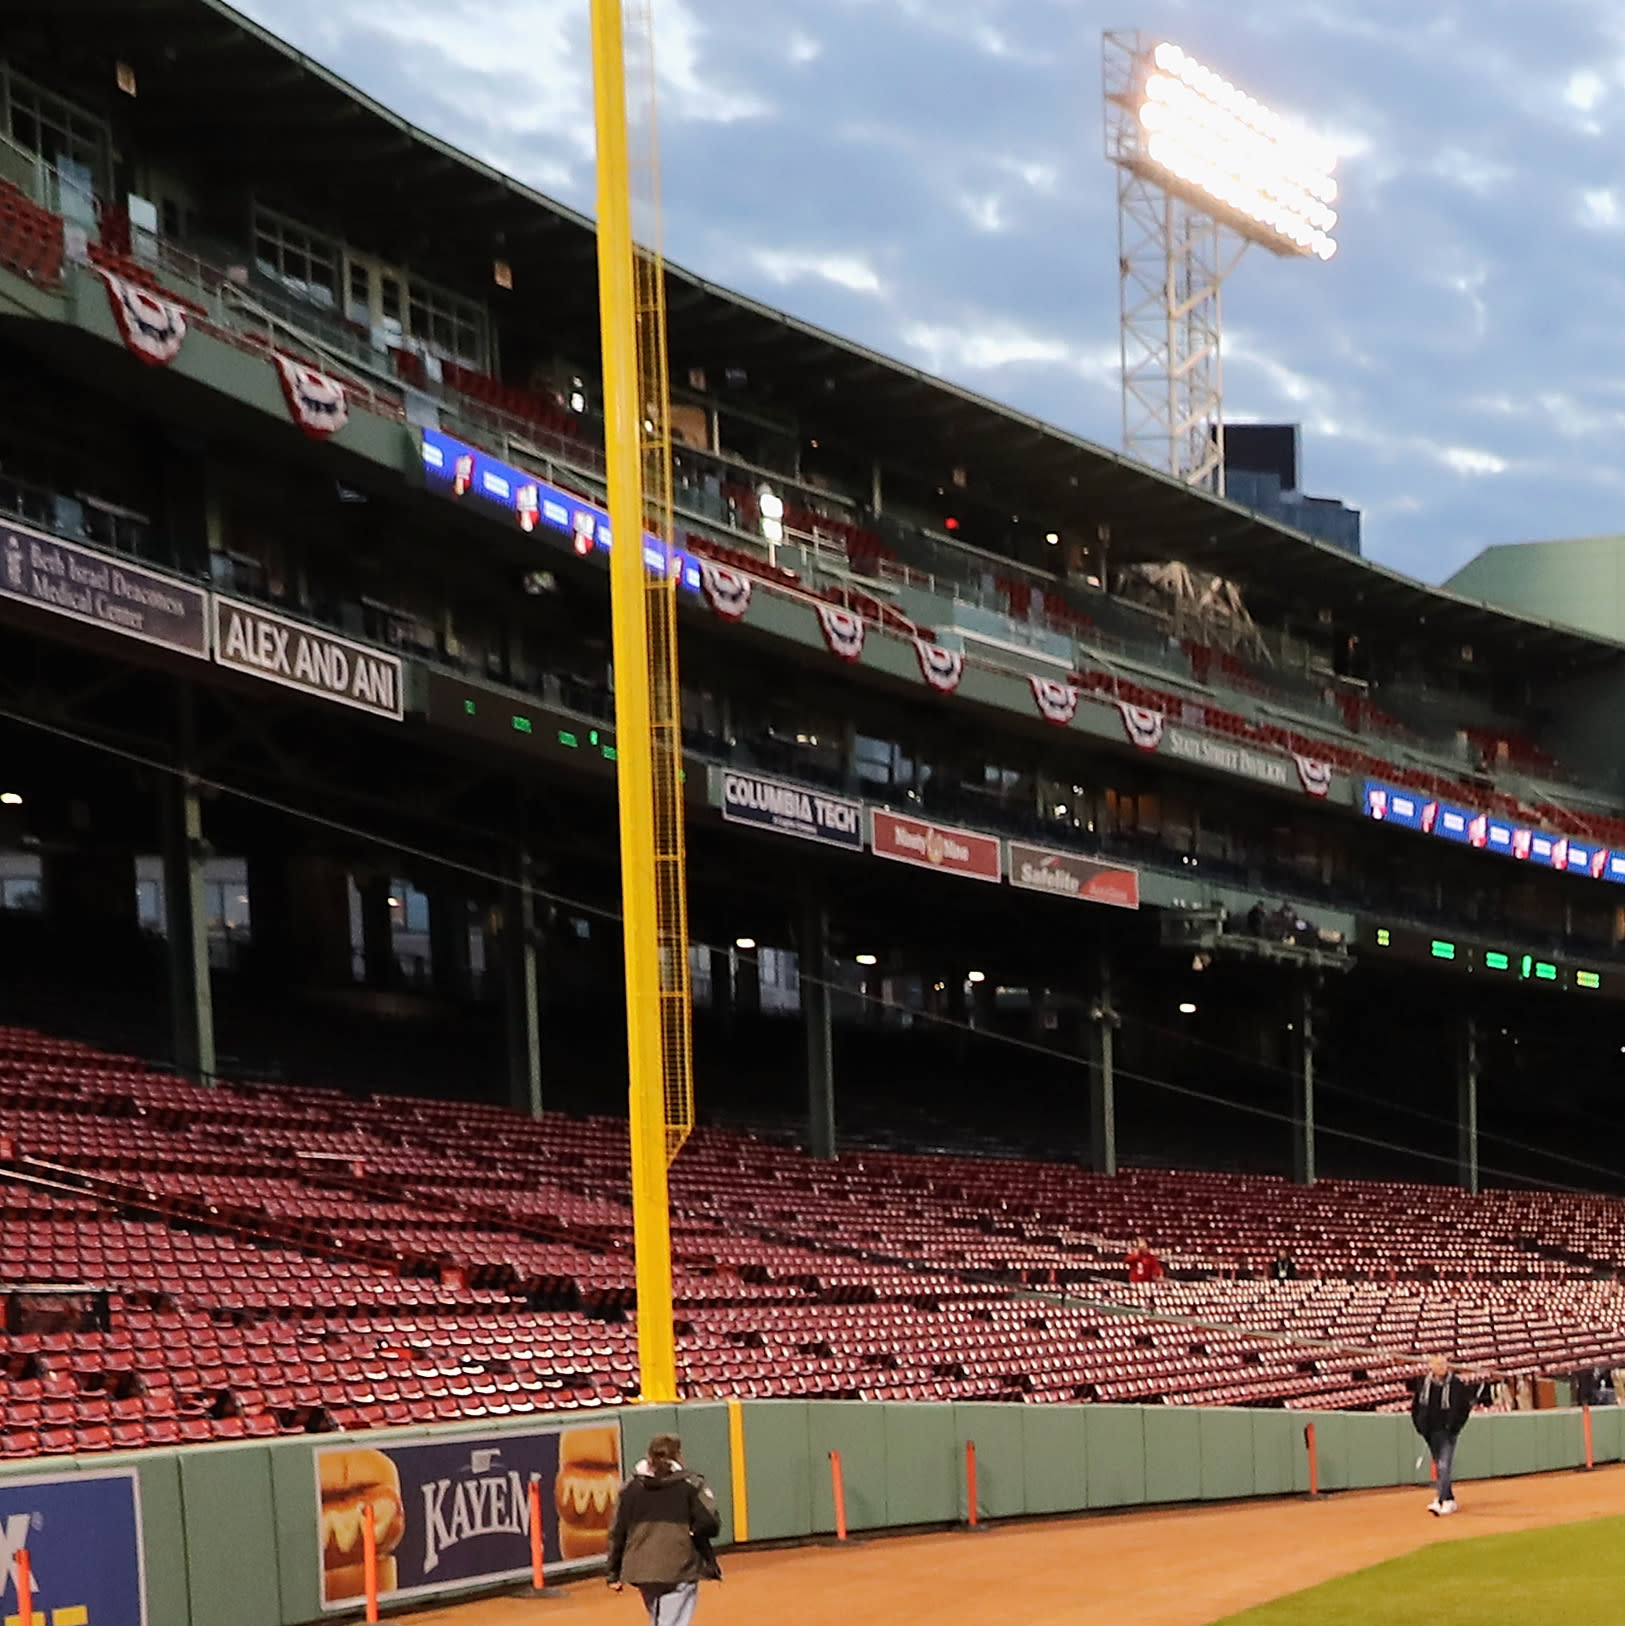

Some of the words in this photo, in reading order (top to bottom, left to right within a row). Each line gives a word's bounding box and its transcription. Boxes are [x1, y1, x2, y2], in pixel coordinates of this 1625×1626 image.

[226, 611, 292, 676] ALEX
[294, 635, 349, 692] AND
[352, 655, 394, 710] ANI
[725, 775, 814, 823] COLUMBIA
[814, 799, 857, 834] TECH
